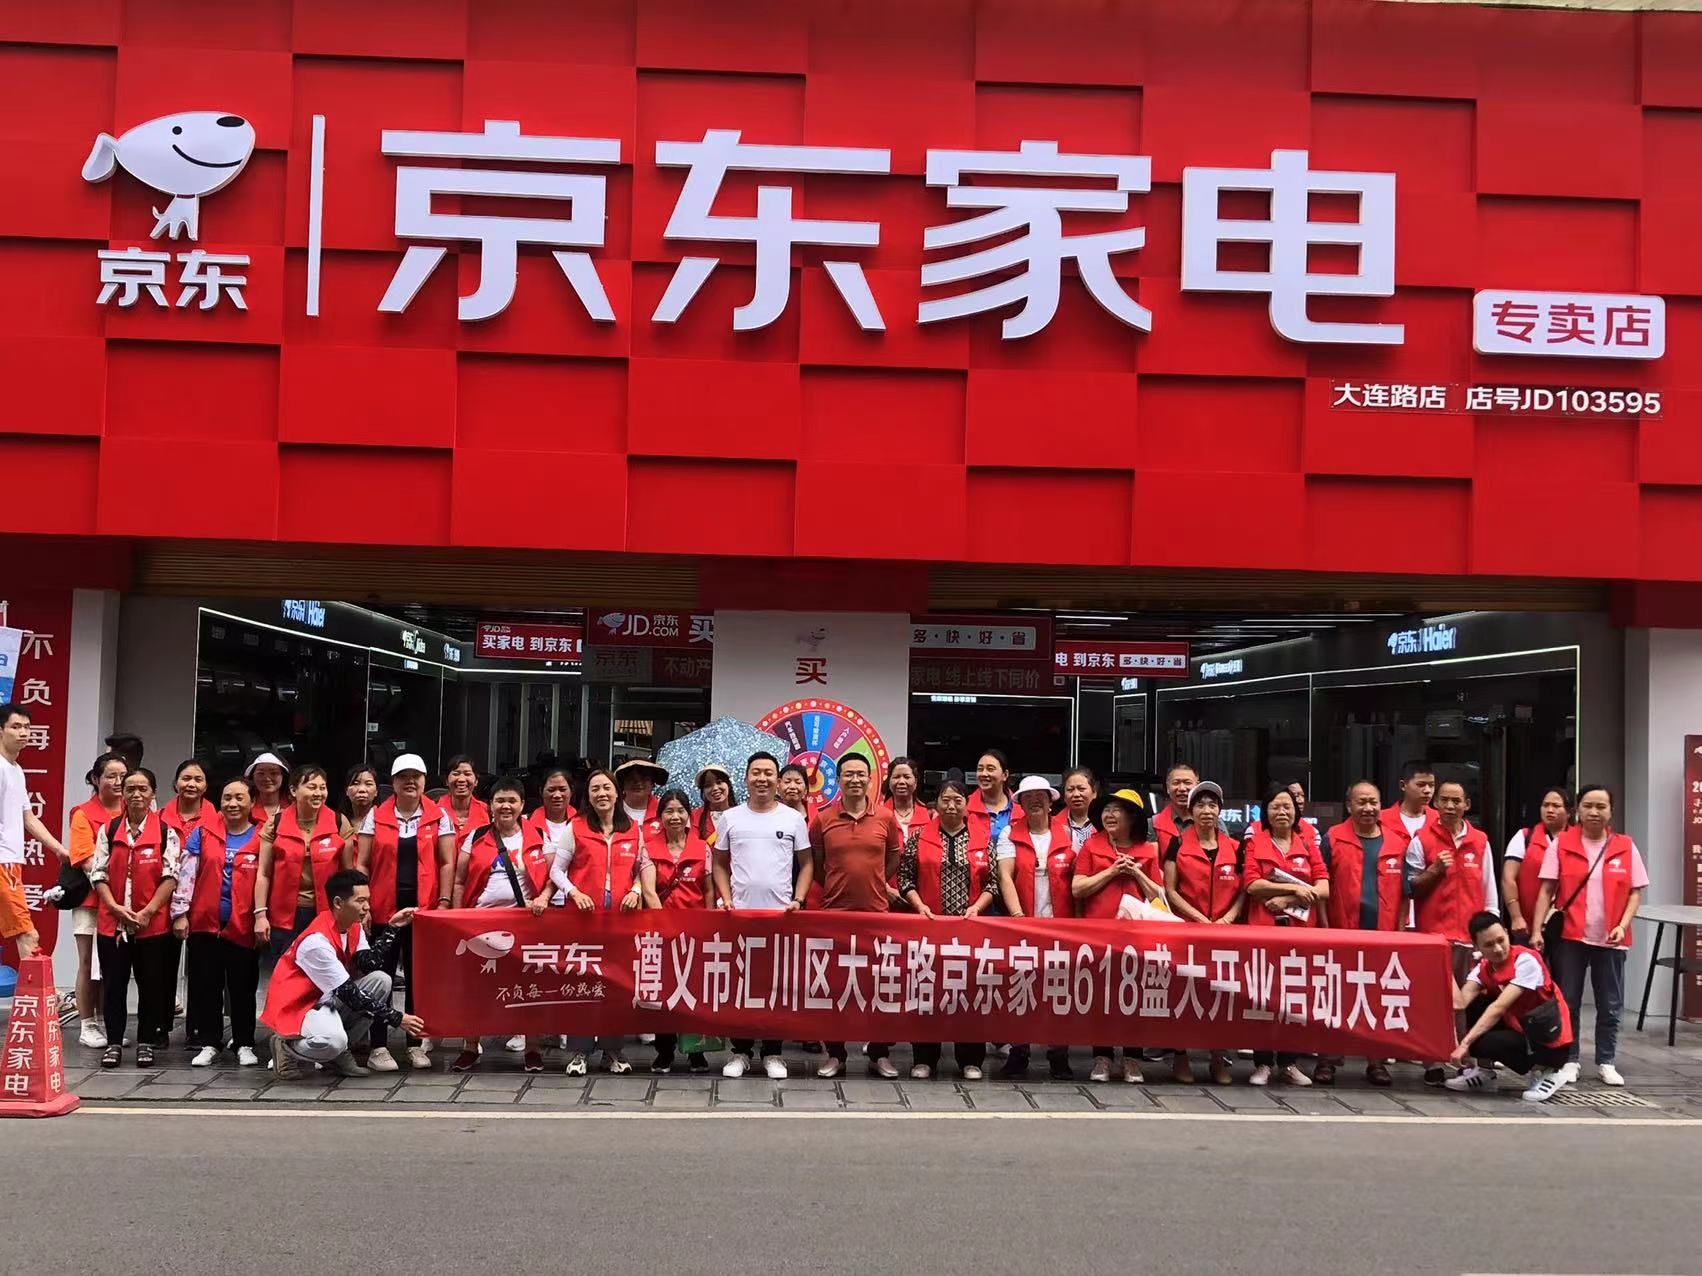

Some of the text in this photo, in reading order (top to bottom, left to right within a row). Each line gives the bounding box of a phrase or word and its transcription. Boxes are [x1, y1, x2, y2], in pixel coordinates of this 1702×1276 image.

[377, 119, 1405, 345] 京东家电
[96, 247, 251, 311] 京东
[1490, 300, 1652, 347] 专卖店
[1333, 382, 1661, 415] 大连路店 店号JD103595
[482, 634, 573, 653] 买家电 到京东
[1423, 623, 1457, 652] Haier
[795, 657, 827, 685] 买
[1072, 653, 1115, 667] 到京东
[520, 942, 604, 976] 京东
[632, 931, 1411, 1033] 遵义市汇川区大连路京东家电618盛大开业启动大会
[4, 994, 40, 1097] 京东家电
[46, 994, 62, 1094] 京东家电
